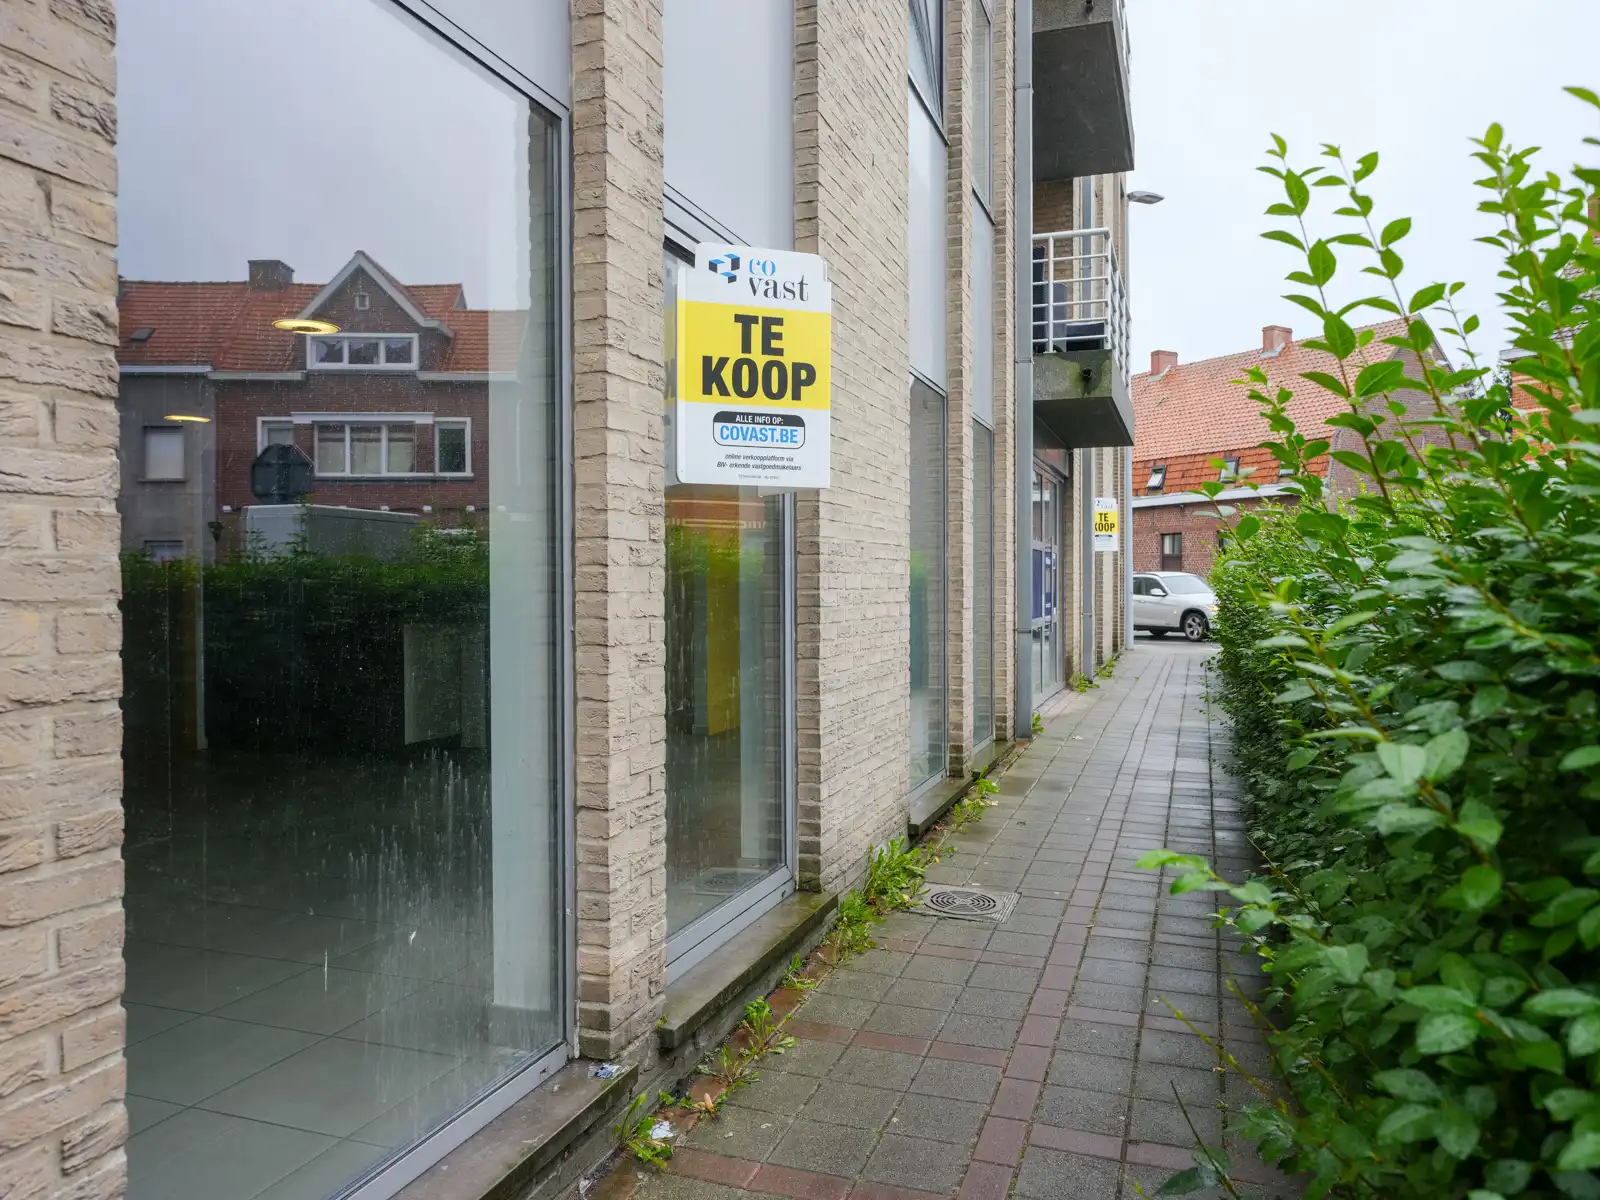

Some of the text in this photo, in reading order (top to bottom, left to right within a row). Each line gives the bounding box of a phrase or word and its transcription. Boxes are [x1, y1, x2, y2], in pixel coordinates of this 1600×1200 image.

[749, 257, 776, 277] co
[749, 274, 809, 302] vast
[734, 313, 784, 357] TE
[702, 355, 817, 402] KOOP
[735, 414, 784, 425] ALLE INFO OP:
[720, 425, 798, 443] COVAST.BE
[729, 461, 751, 469] erkende
[752, 463, 802, 472] vastgoedmakelaars
[742, 453, 785, 463] verkoopplatform
[1098, 513, 1108, 522] TE
